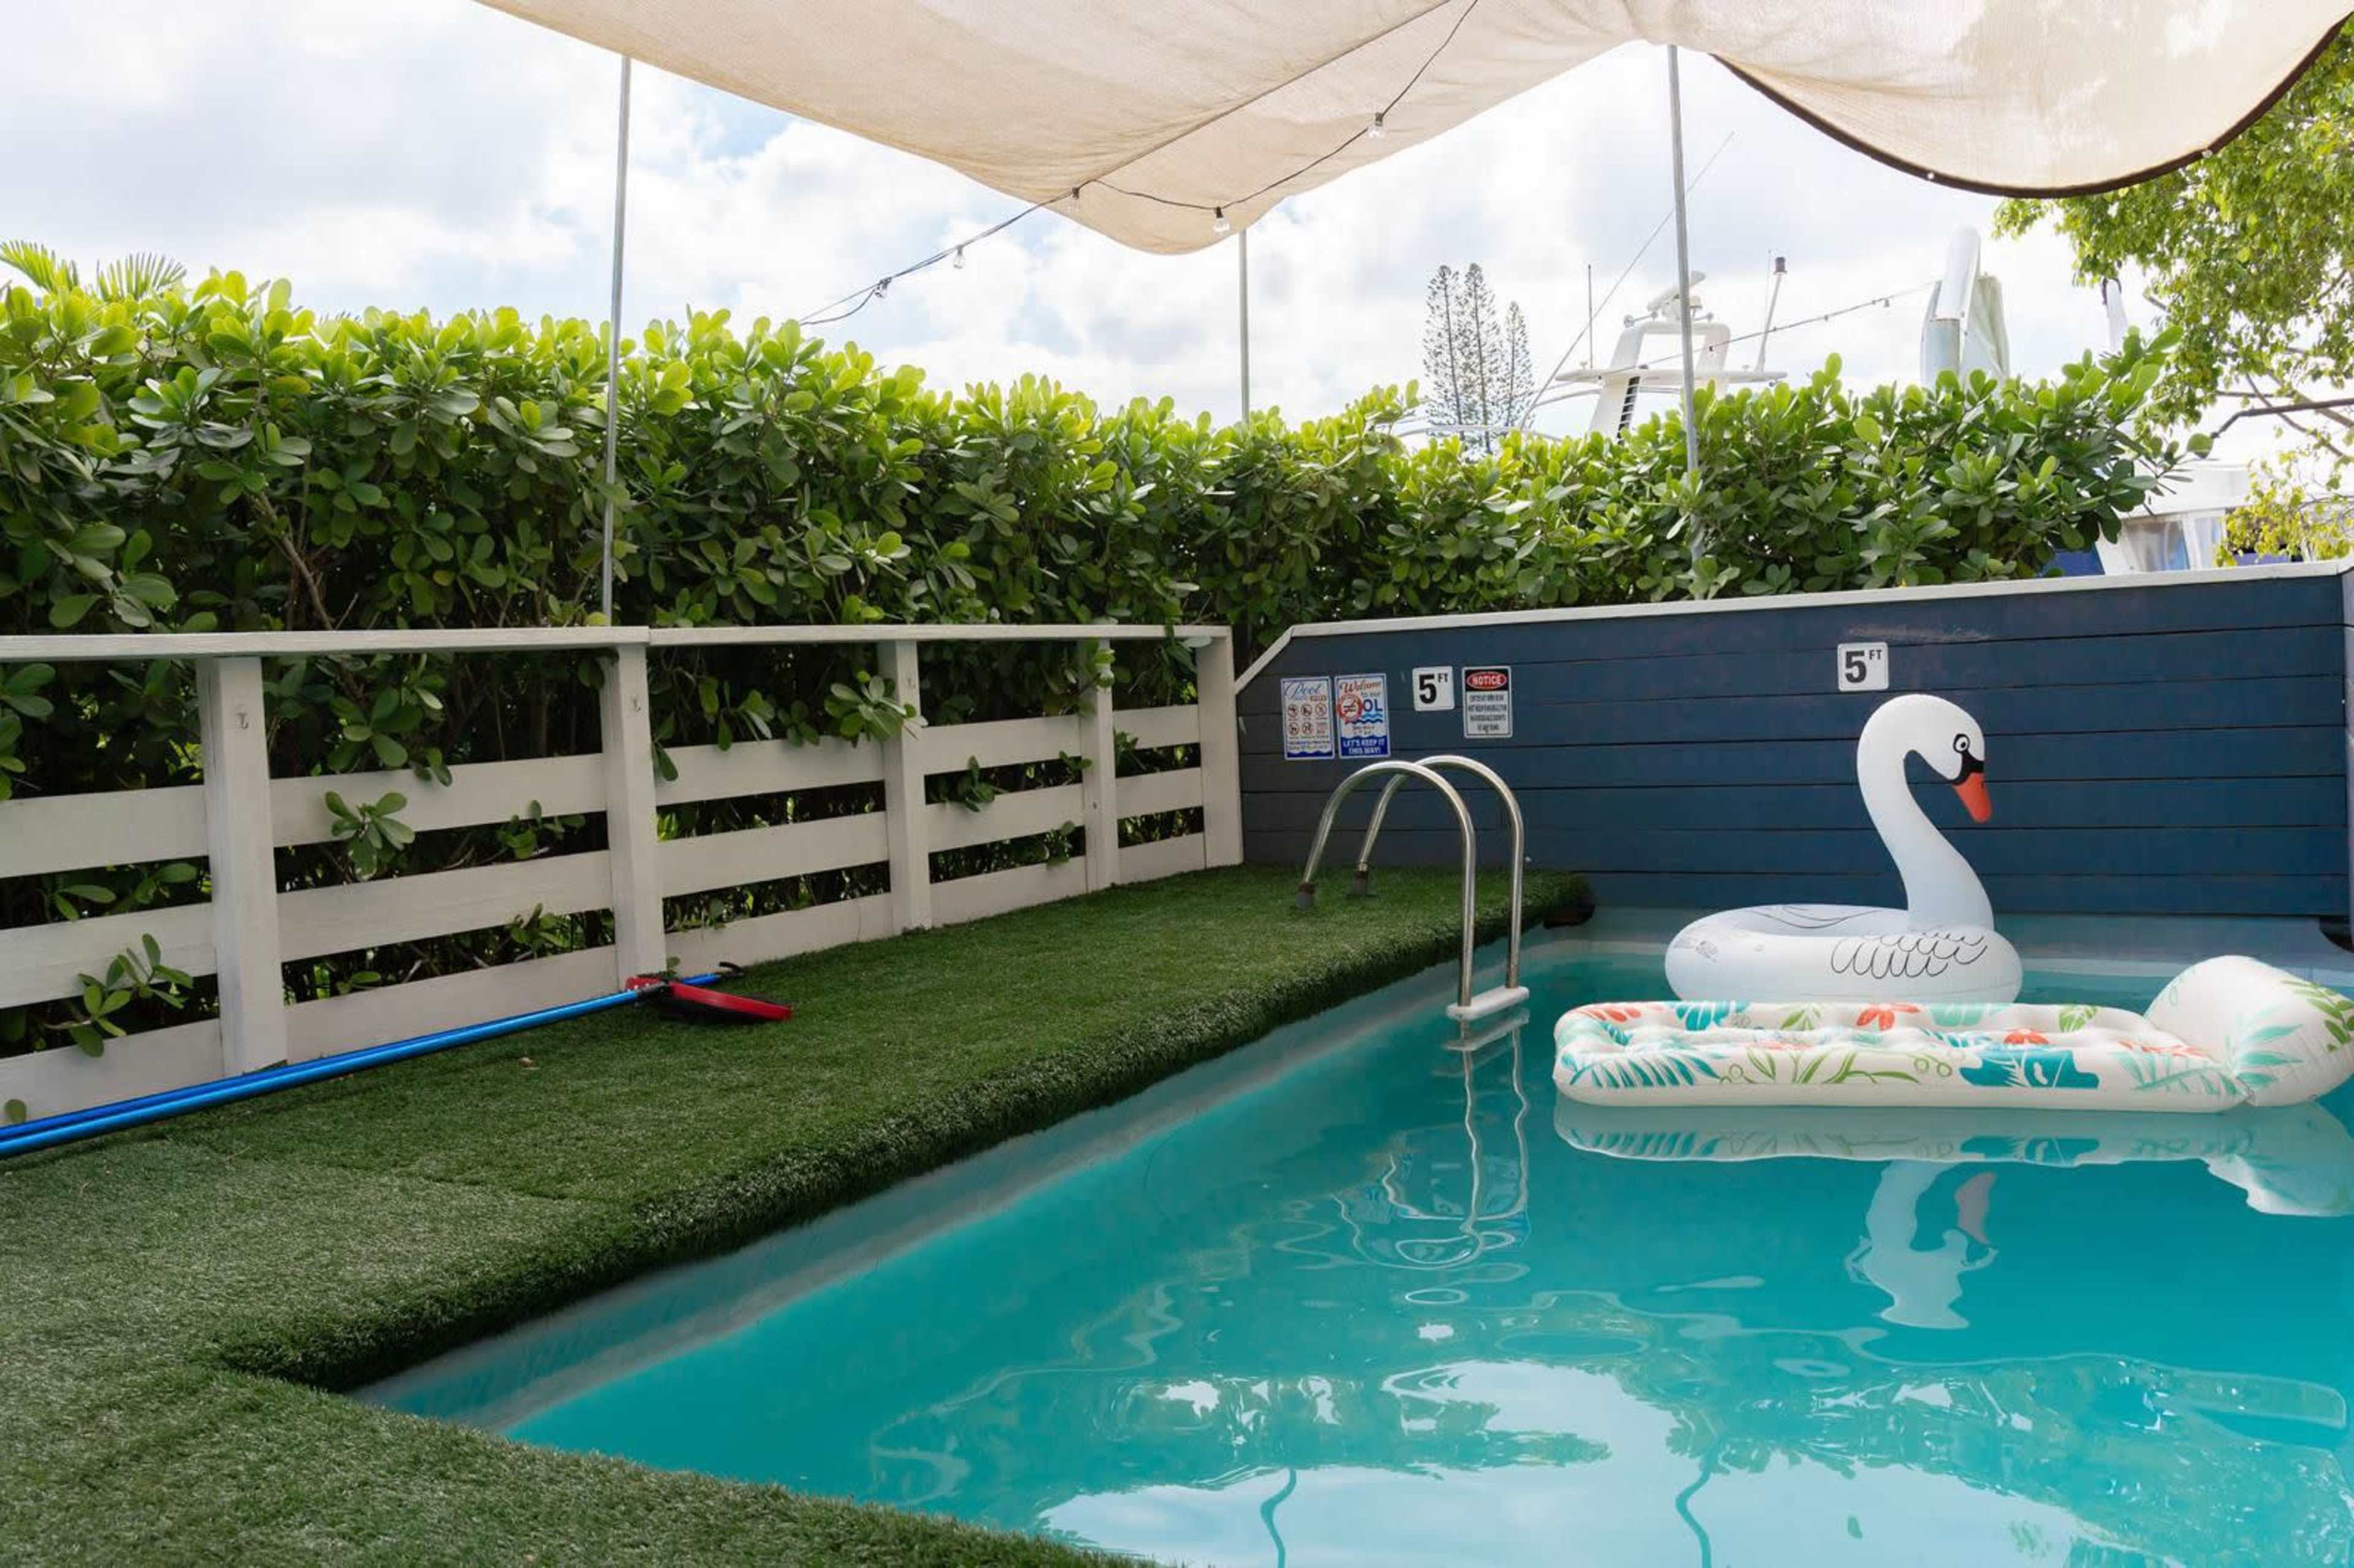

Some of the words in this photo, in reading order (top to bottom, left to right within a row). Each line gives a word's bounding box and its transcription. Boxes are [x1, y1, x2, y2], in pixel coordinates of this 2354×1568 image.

[1472, 675, 1503, 685] NOTICE
[1845, 651, 1867, 683] 5
[1869, 649, 1883, 660] FT
[1419, 674, 1437, 704] 5
[1438, 673, 1448, 683] FT
